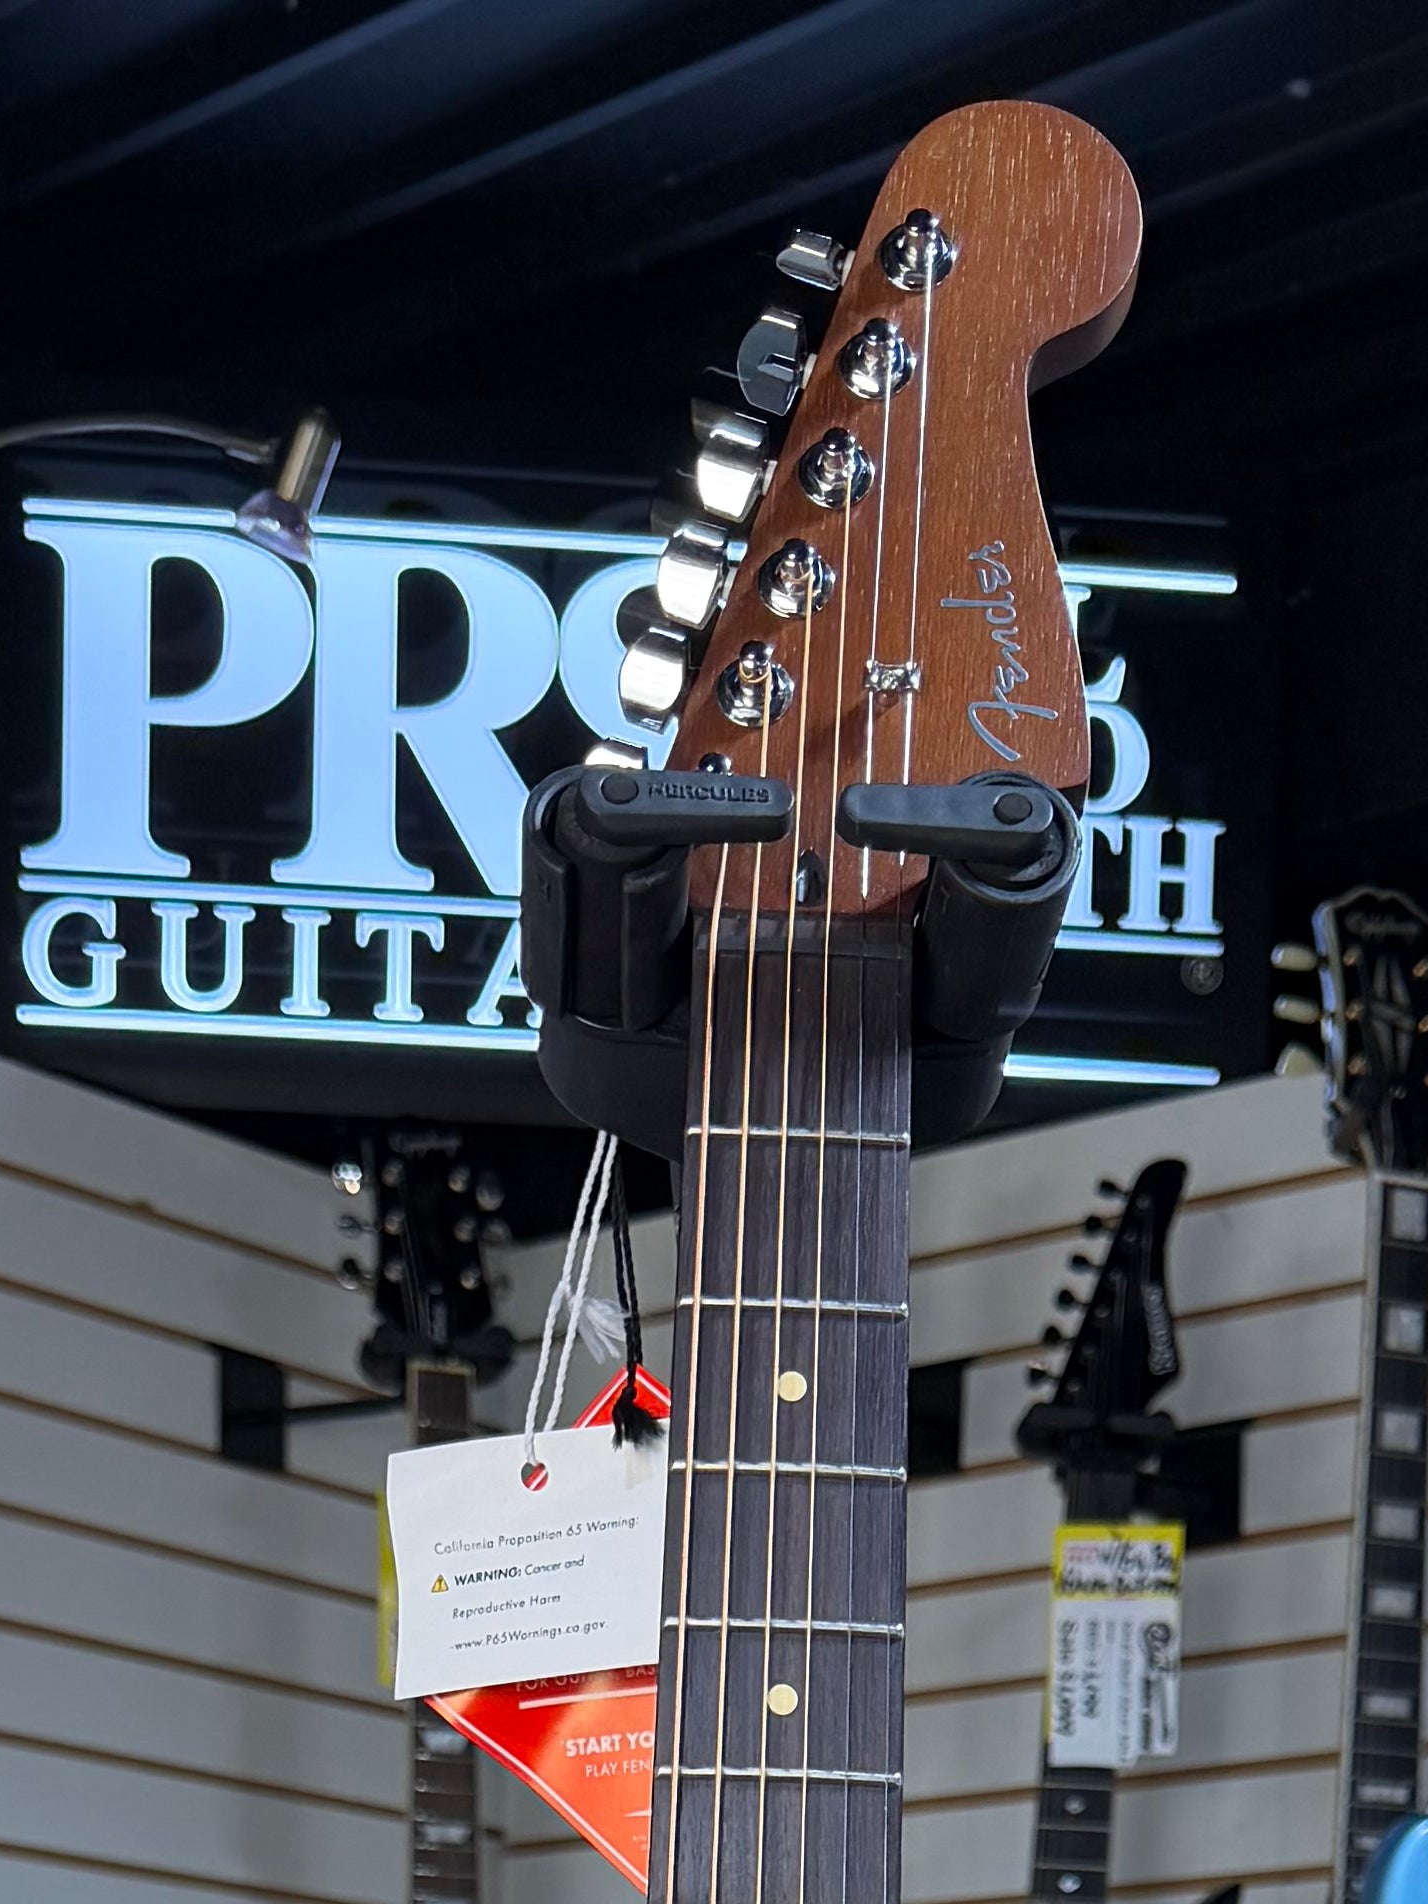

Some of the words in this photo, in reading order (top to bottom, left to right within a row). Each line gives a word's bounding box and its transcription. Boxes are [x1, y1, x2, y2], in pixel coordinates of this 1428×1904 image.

[940, 538, 1060, 762] Fender
[648, 782, 770, 804] HERCULES
[433, 1537, 494, 1555] California
[498, 1529, 563, 1549] Proposition
[566, 1523, 582, 1536] 65
[586, 1515, 640, 1534] Warning:
[454, 1566, 522, 1587] WARNING:
[524, 1561, 562, 1576] Cancer
[564, 1555, 585, 1569] and
[452, 1599, 525, 1620] Reproductive
[529, 1593, 561, 1606] Harm
[566, 1734, 622, 1757] START
[626, 1731, 655, 1750] YO
[585, 1762, 617, 1778] PLAY
[623, 1759, 652, 1775] FEN
